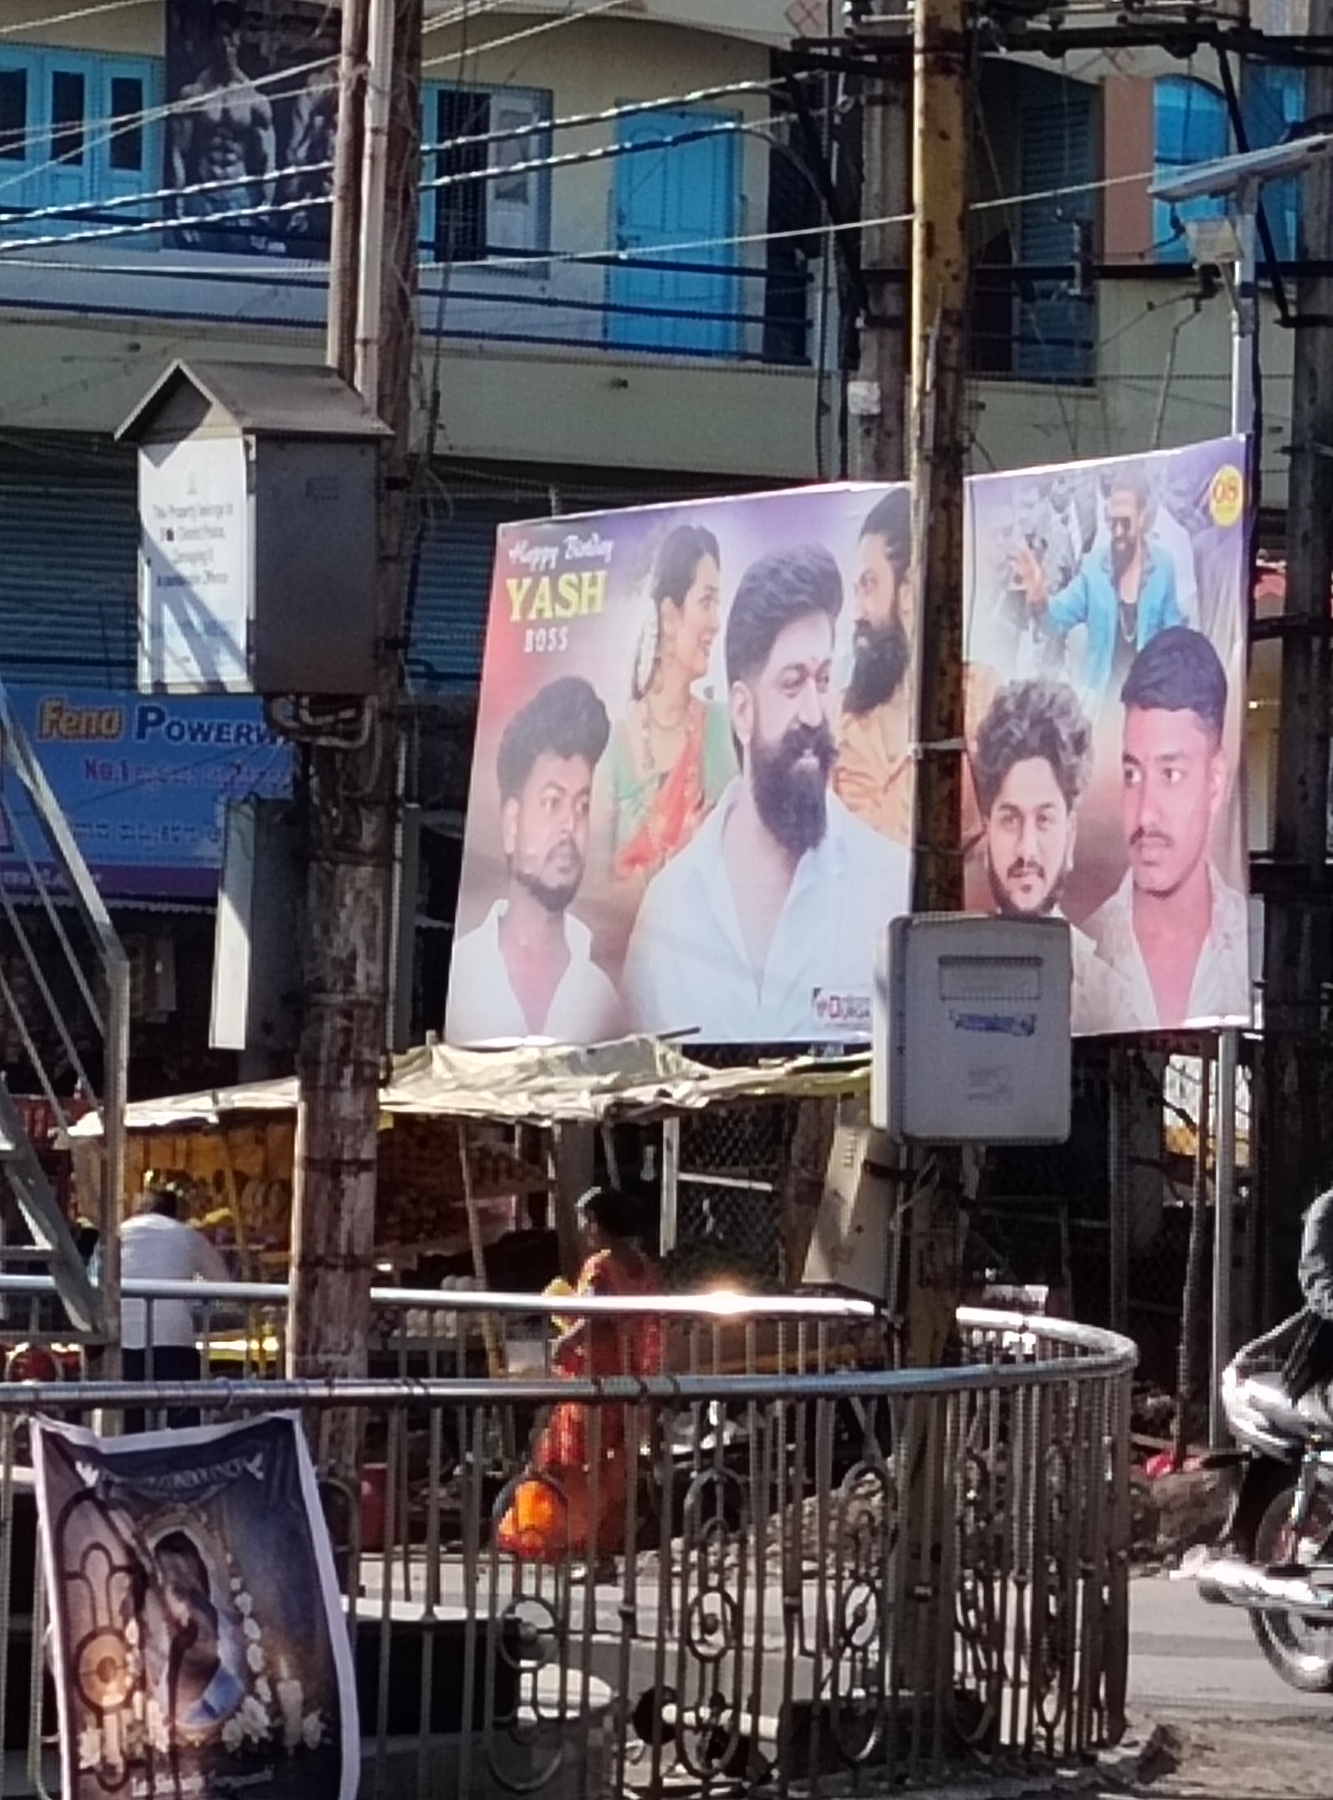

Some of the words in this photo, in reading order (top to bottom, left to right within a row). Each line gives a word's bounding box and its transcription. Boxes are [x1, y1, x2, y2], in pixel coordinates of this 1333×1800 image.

[508, 540, 559, 572] Happy
[506, 569, 608, 622] YASH
[523, 625, 569, 653] BOSS
